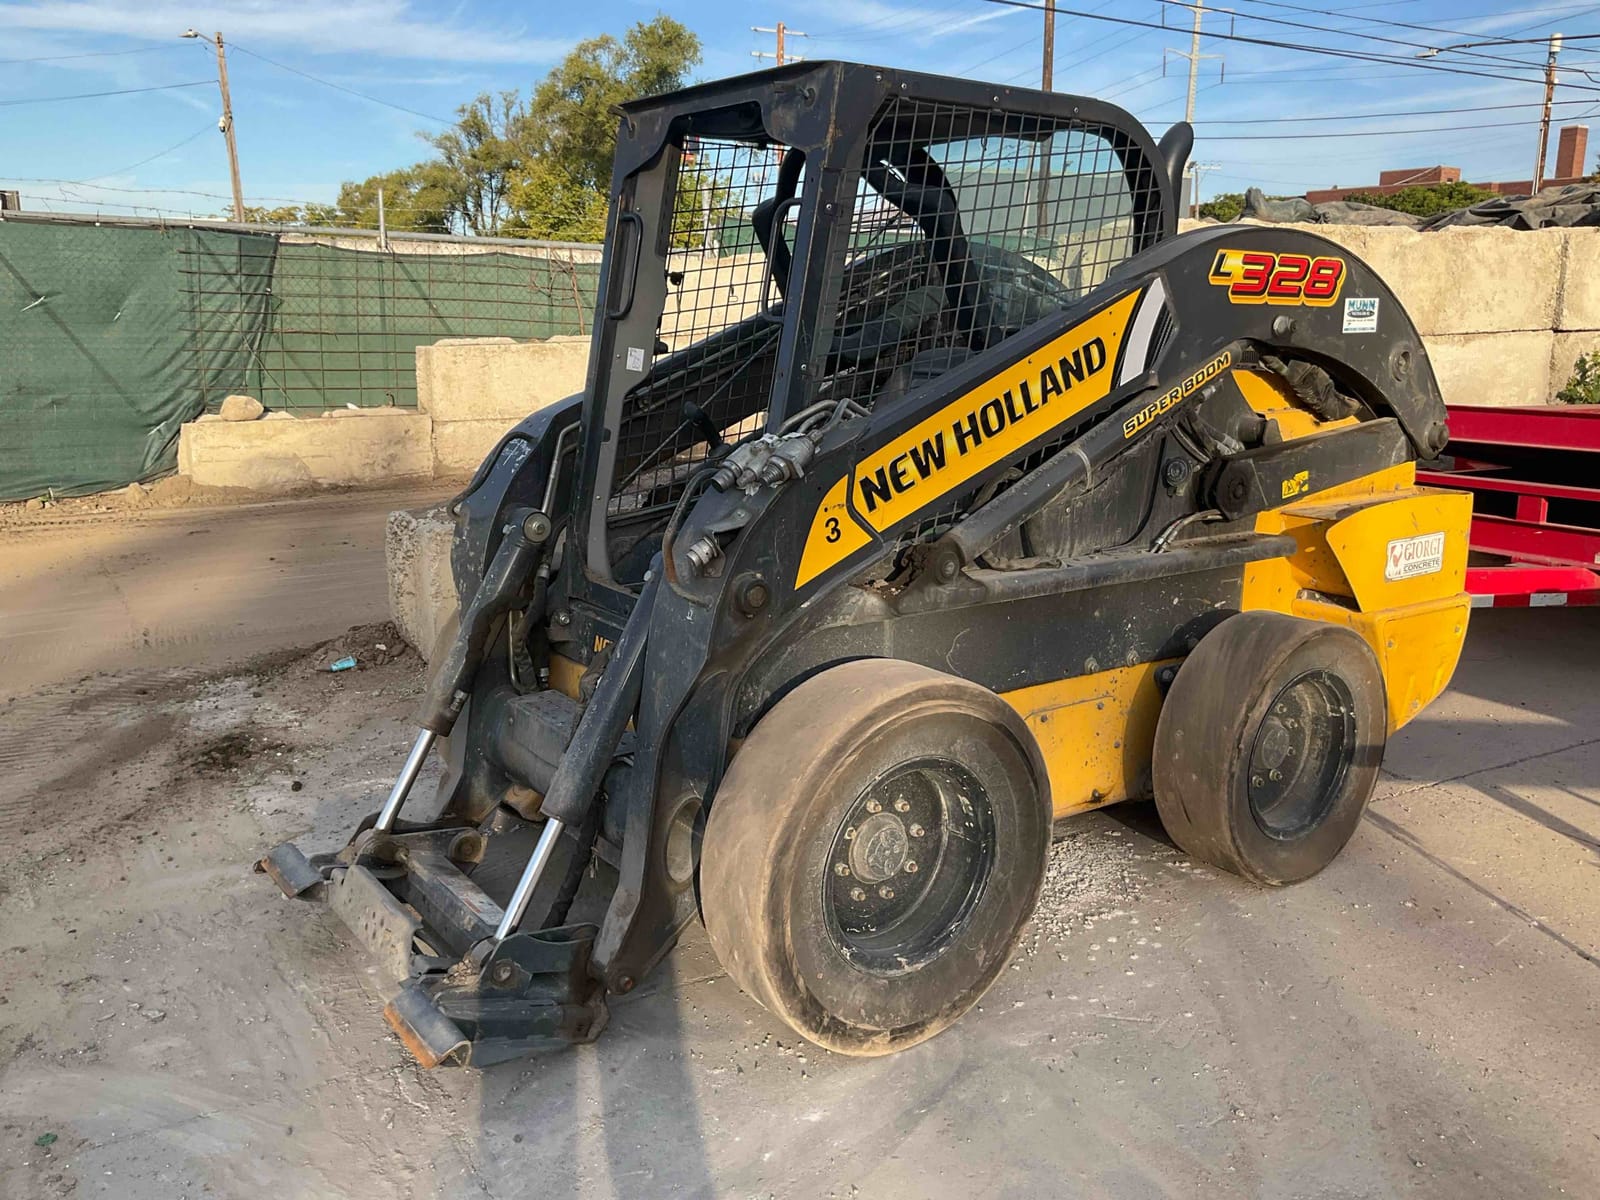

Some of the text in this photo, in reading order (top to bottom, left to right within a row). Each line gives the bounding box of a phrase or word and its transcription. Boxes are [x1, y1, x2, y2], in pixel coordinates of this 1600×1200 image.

[1209, 249, 1346, 307] L328
[1347, 299, 1376, 311] MUNN
[1123, 352, 1231, 439] SUPER BOOM
[859, 337, 1107, 514] NEW HOLLAND
[825, 517, 841, 543] 3
[1404, 537, 1442, 561] GIORGI
[1403, 558, 1441, 573] CONCRETE
